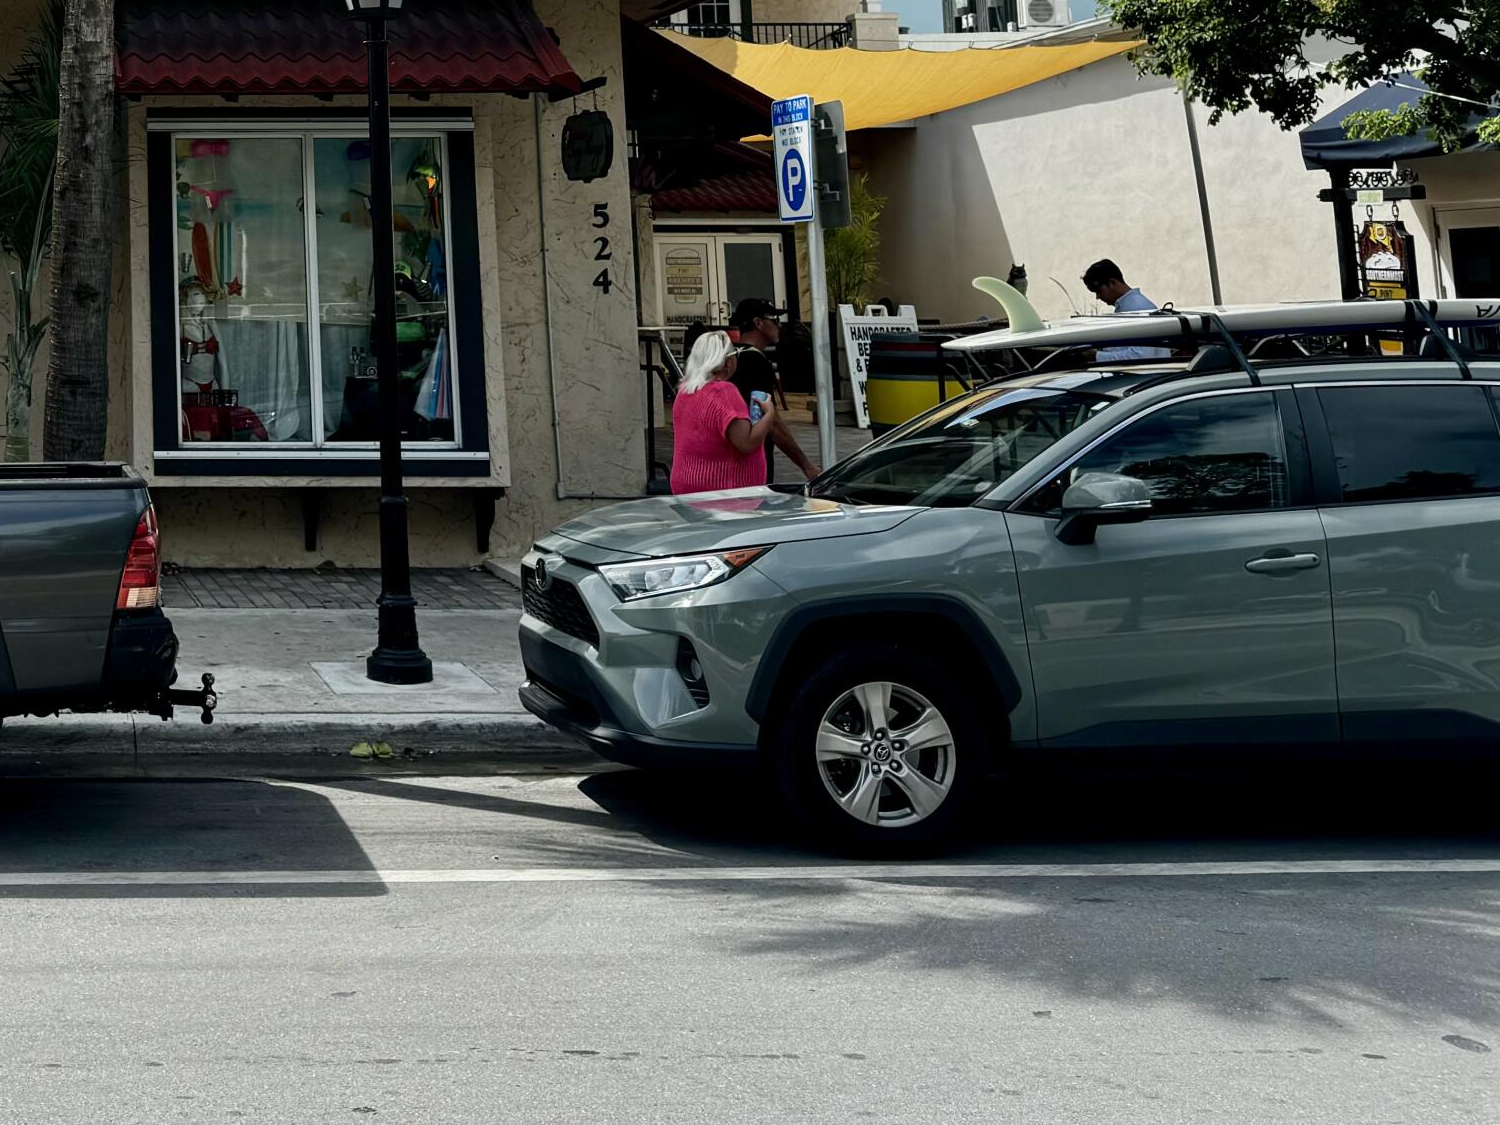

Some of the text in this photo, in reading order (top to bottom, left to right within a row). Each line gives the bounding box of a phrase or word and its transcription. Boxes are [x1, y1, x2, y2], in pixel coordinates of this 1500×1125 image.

[773, 98, 807, 115] PAY TO PARK
[787, 158, 802, 202] P
[591, 202, 613, 295] 524
